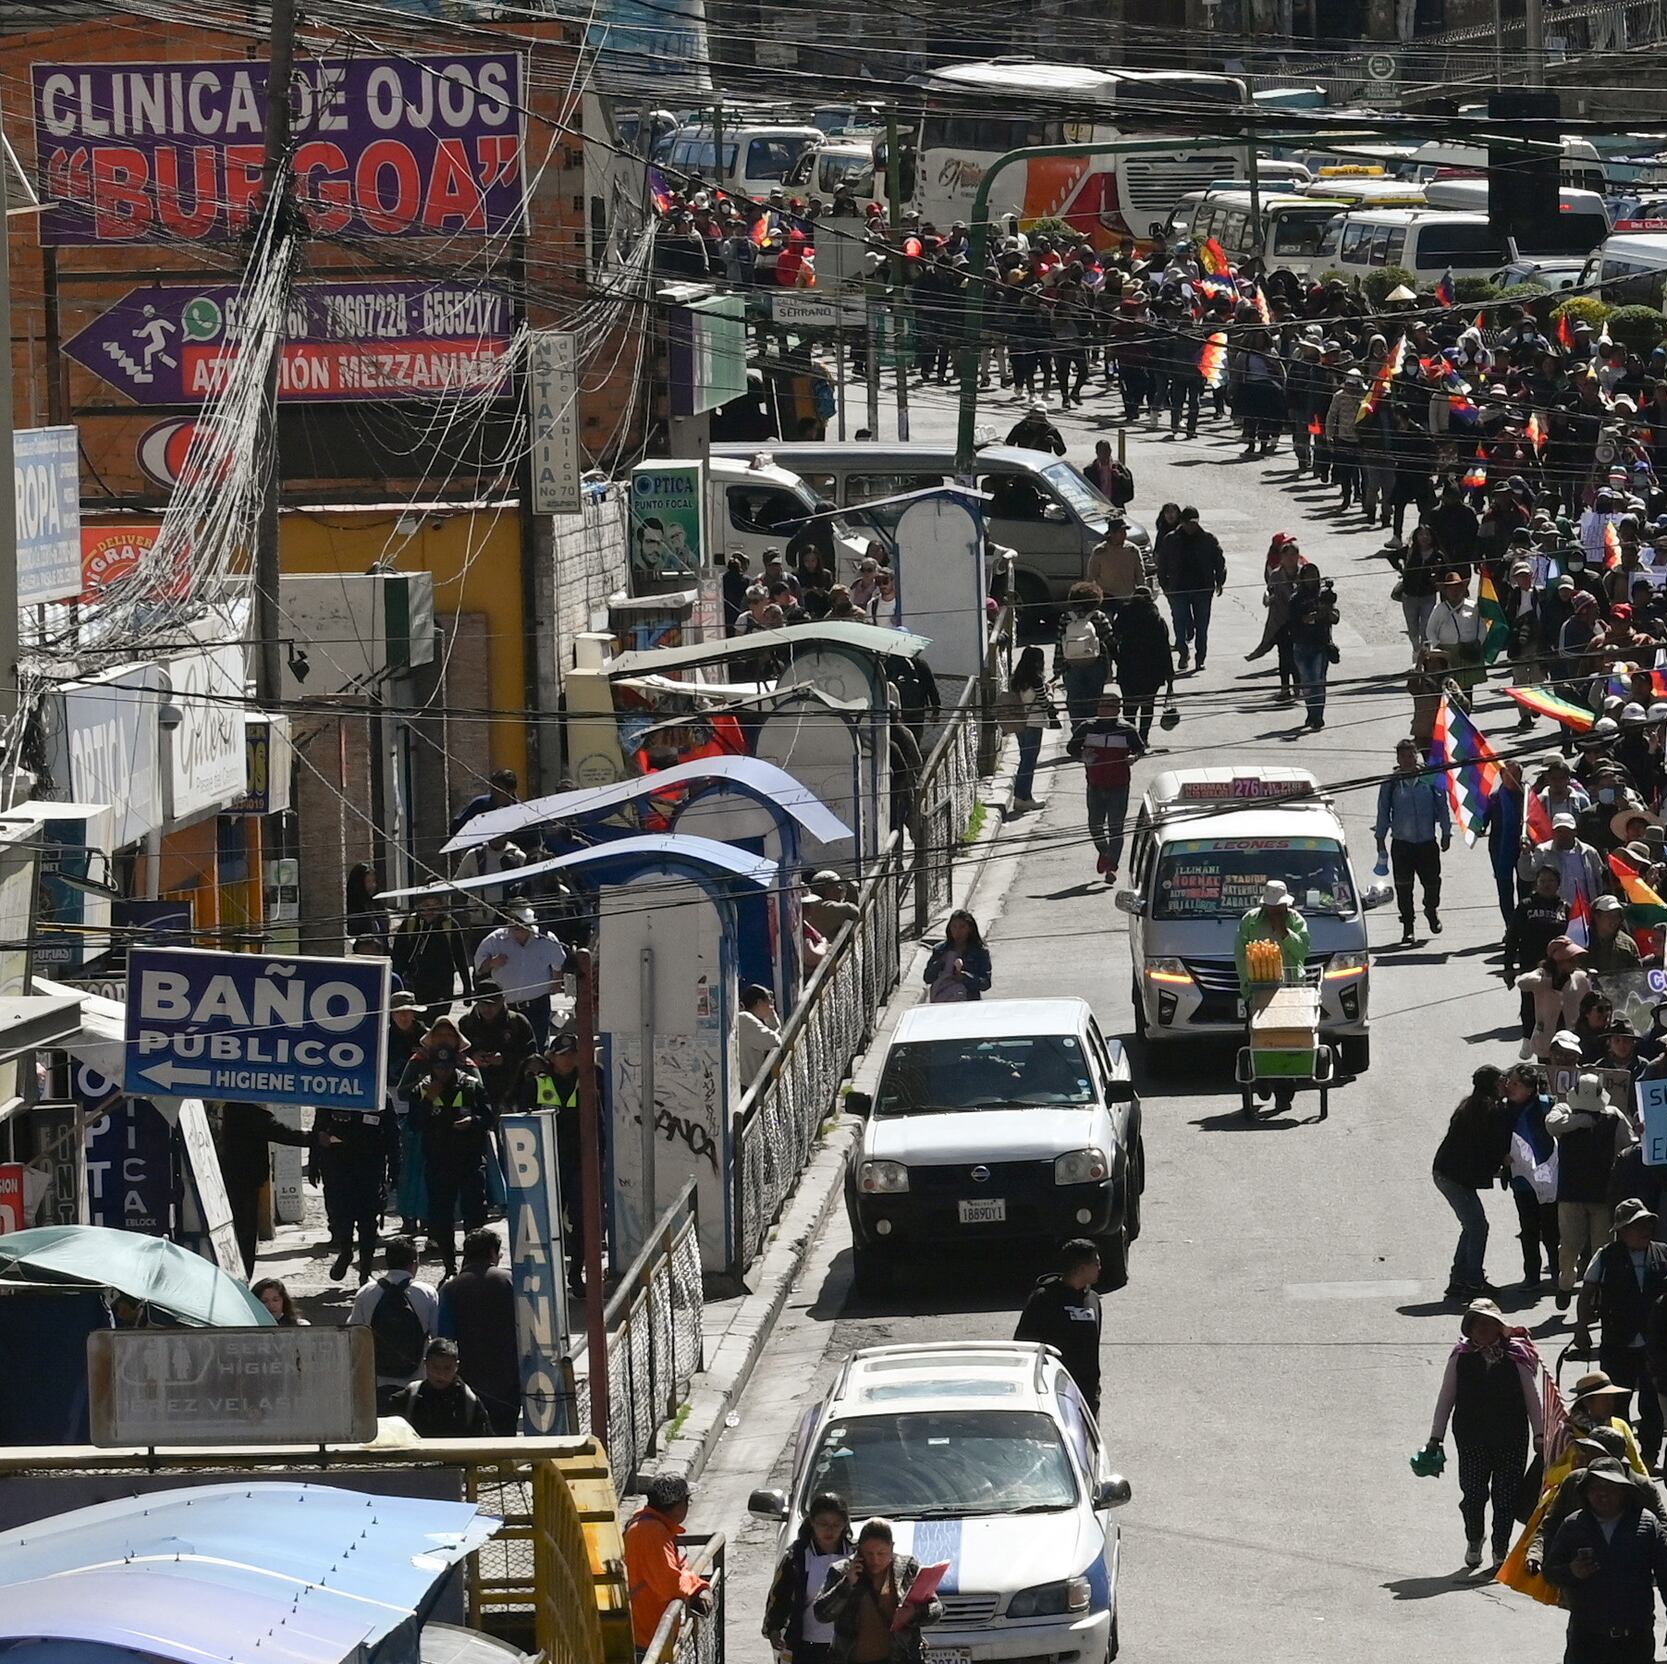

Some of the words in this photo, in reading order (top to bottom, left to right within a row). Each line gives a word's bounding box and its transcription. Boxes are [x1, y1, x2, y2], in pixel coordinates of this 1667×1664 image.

[43, 71, 262, 136] CLINICA
[288, 68, 349, 131] DE
[366, 63, 507, 129] OJOS
[779, 308, 832, 318] SERRANO
[536, 342, 556, 483] NOTARIA
[14, 463, 62, 541] ROPA
[561, 486, 576, 497] 70
[1235, 780, 1259, 797] 276
[1211, 839, 1292, 851] LEONES
[140, 962, 368, 1034] BAÑO
[139, 1026, 366, 1068] PÚBLICO
[215, 1070, 296, 1093] HIGIENE
[300, 1074, 364, 1096] TOTAL
[504, 1127, 557, 1434] BAÑO
